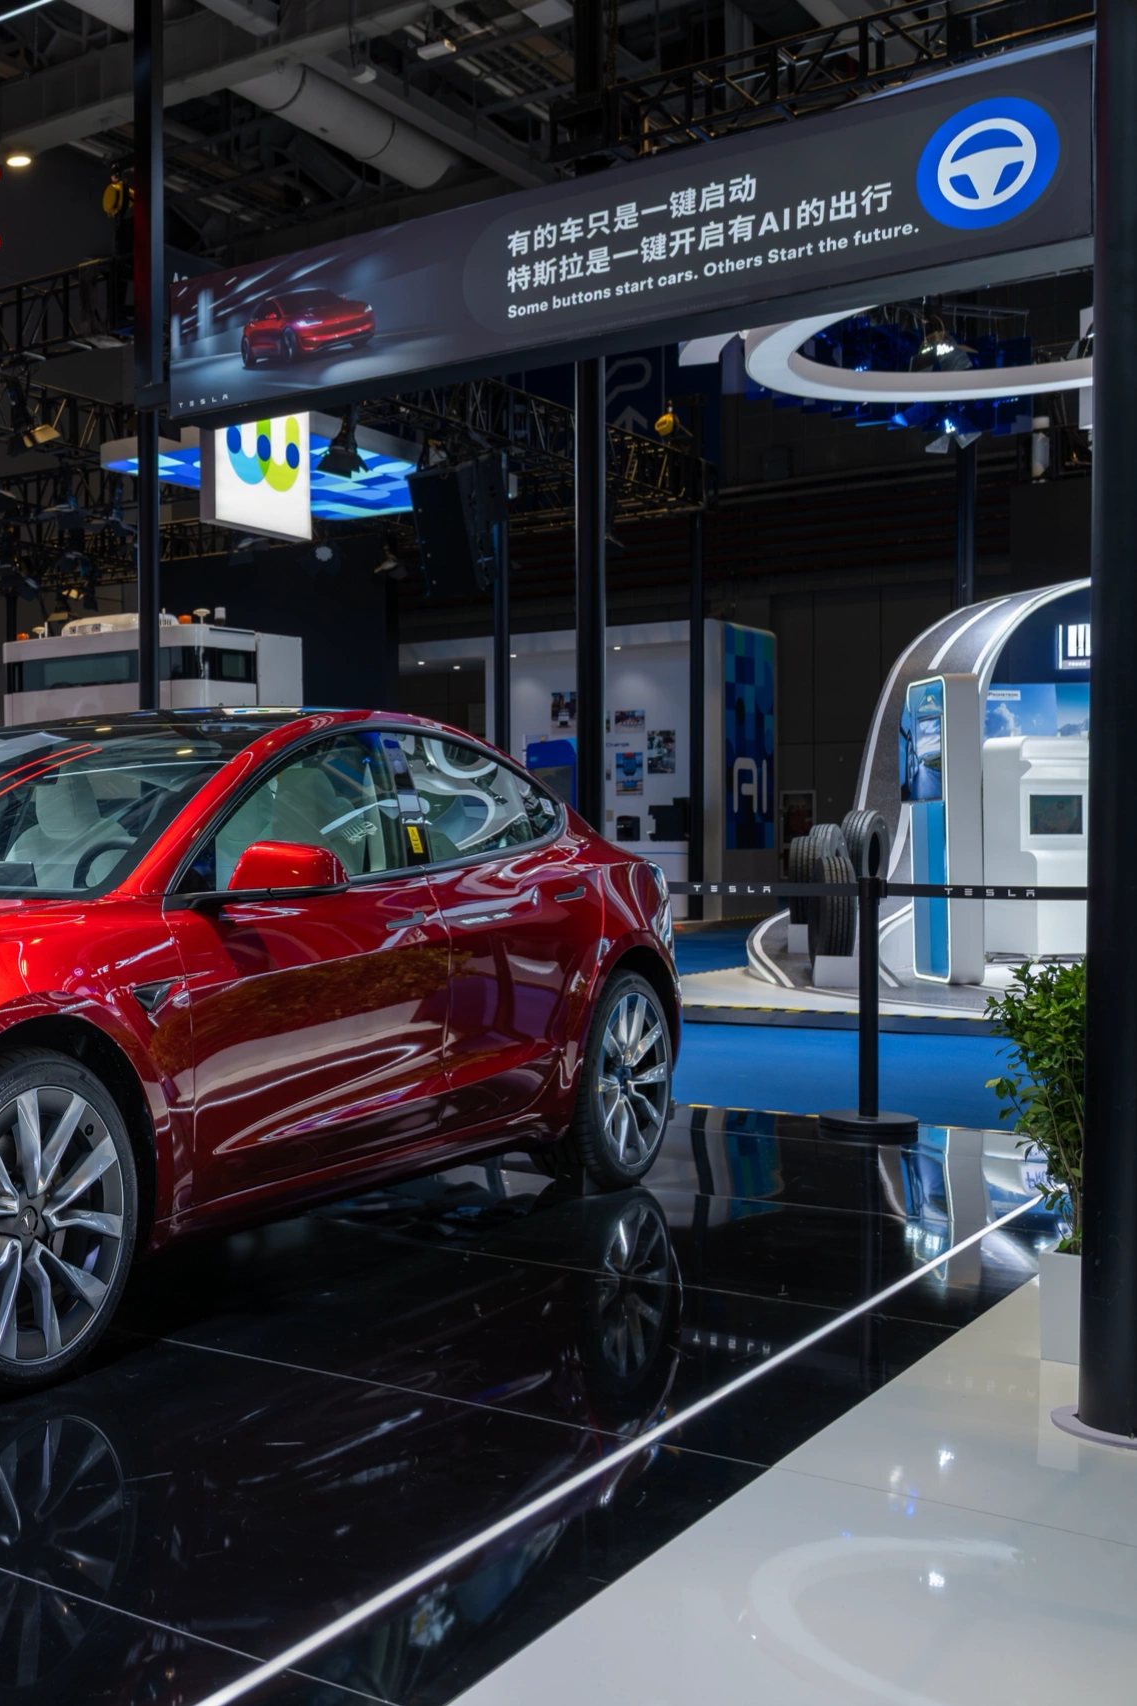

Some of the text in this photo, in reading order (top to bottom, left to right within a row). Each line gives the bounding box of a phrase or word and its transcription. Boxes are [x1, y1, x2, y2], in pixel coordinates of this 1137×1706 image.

[507, 174, 757, 257] 有的车只是一键启动
[507, 182, 892, 293] 特斯拉是一键开启有AI的出行
[508, 300, 548, 318] Some
[552, 287, 611, 309] buttons
[615, 276, 653, 296] start
[657, 270, 698, 287] cars.
[704, 254, 763, 277] Others
[768, 242, 813, 264] Start
[818, 236, 848, 253] the
[853, 223, 919, 245] future.
[178, 393, 228, 408] TESLA
[733, 757, 767, 813] AI
[693, 884, 771, 894] TESLA
[944, 887, 1035, 898] TESLA
